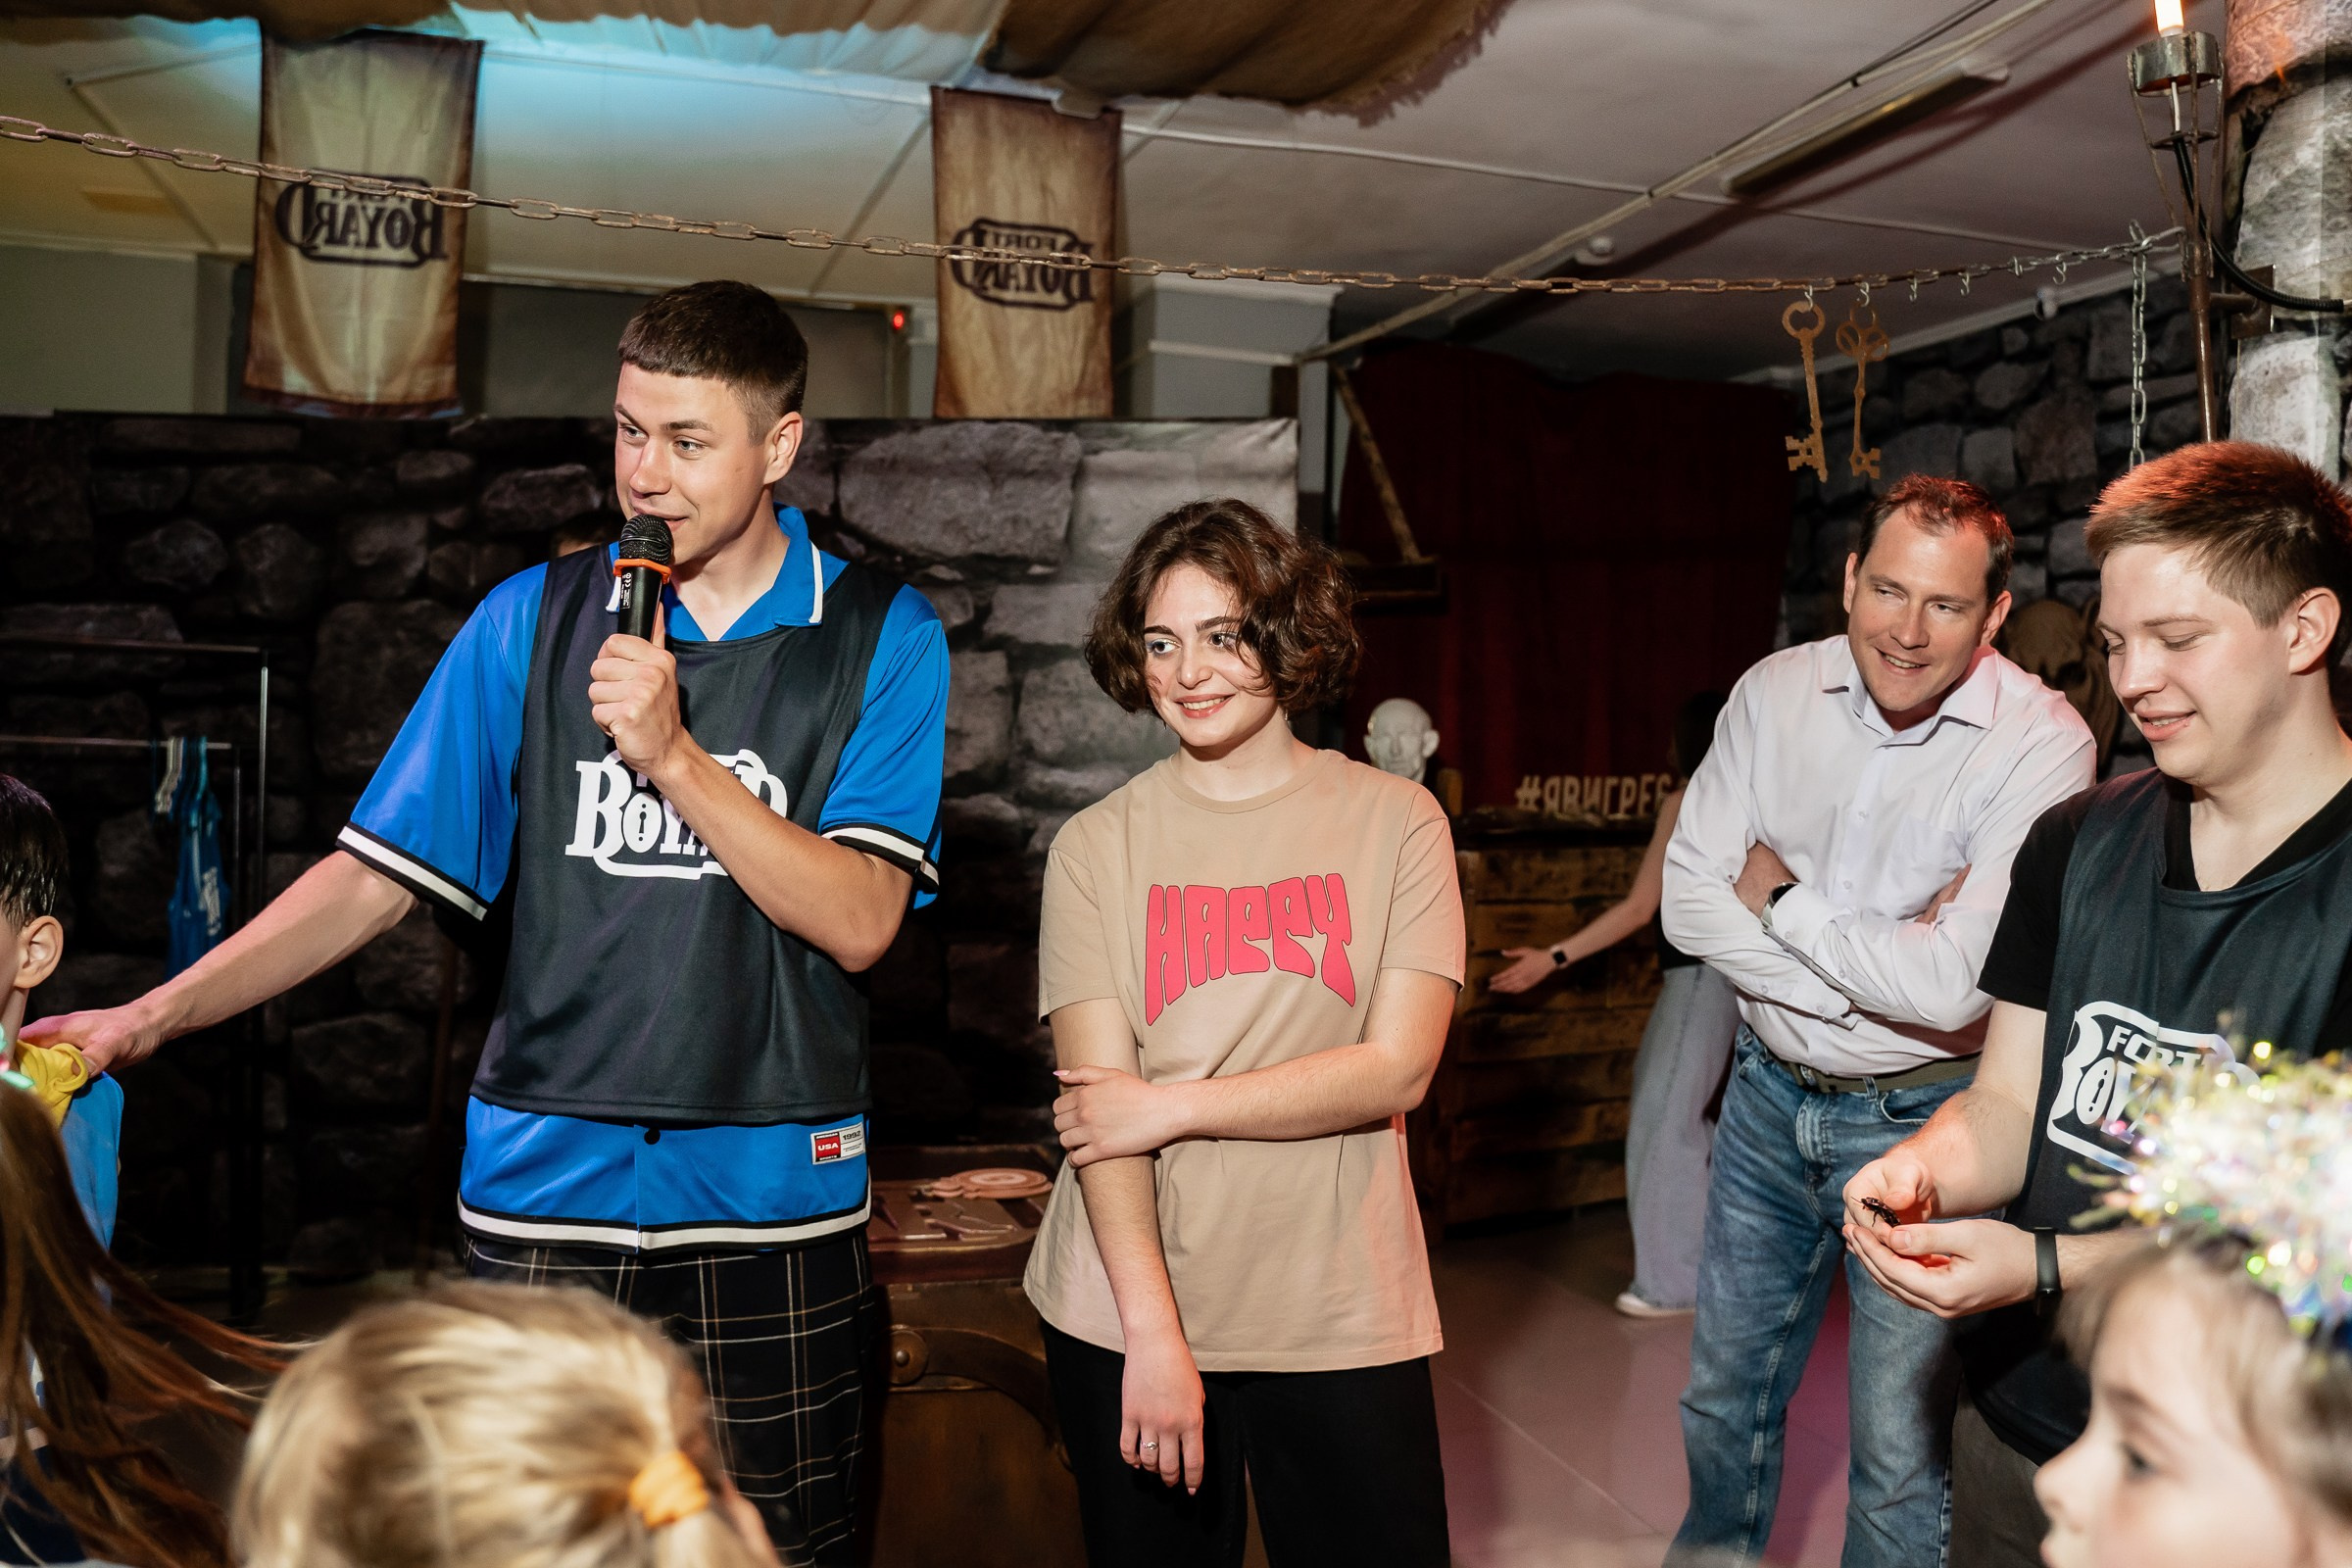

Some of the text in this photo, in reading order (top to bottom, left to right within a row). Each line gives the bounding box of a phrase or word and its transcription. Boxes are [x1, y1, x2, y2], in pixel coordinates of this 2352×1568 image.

[1145, 872, 1356, 1027] HAPPY
[842, 1130, 861, 1141] 1992
[817, 1142, 839, 1152] USA
